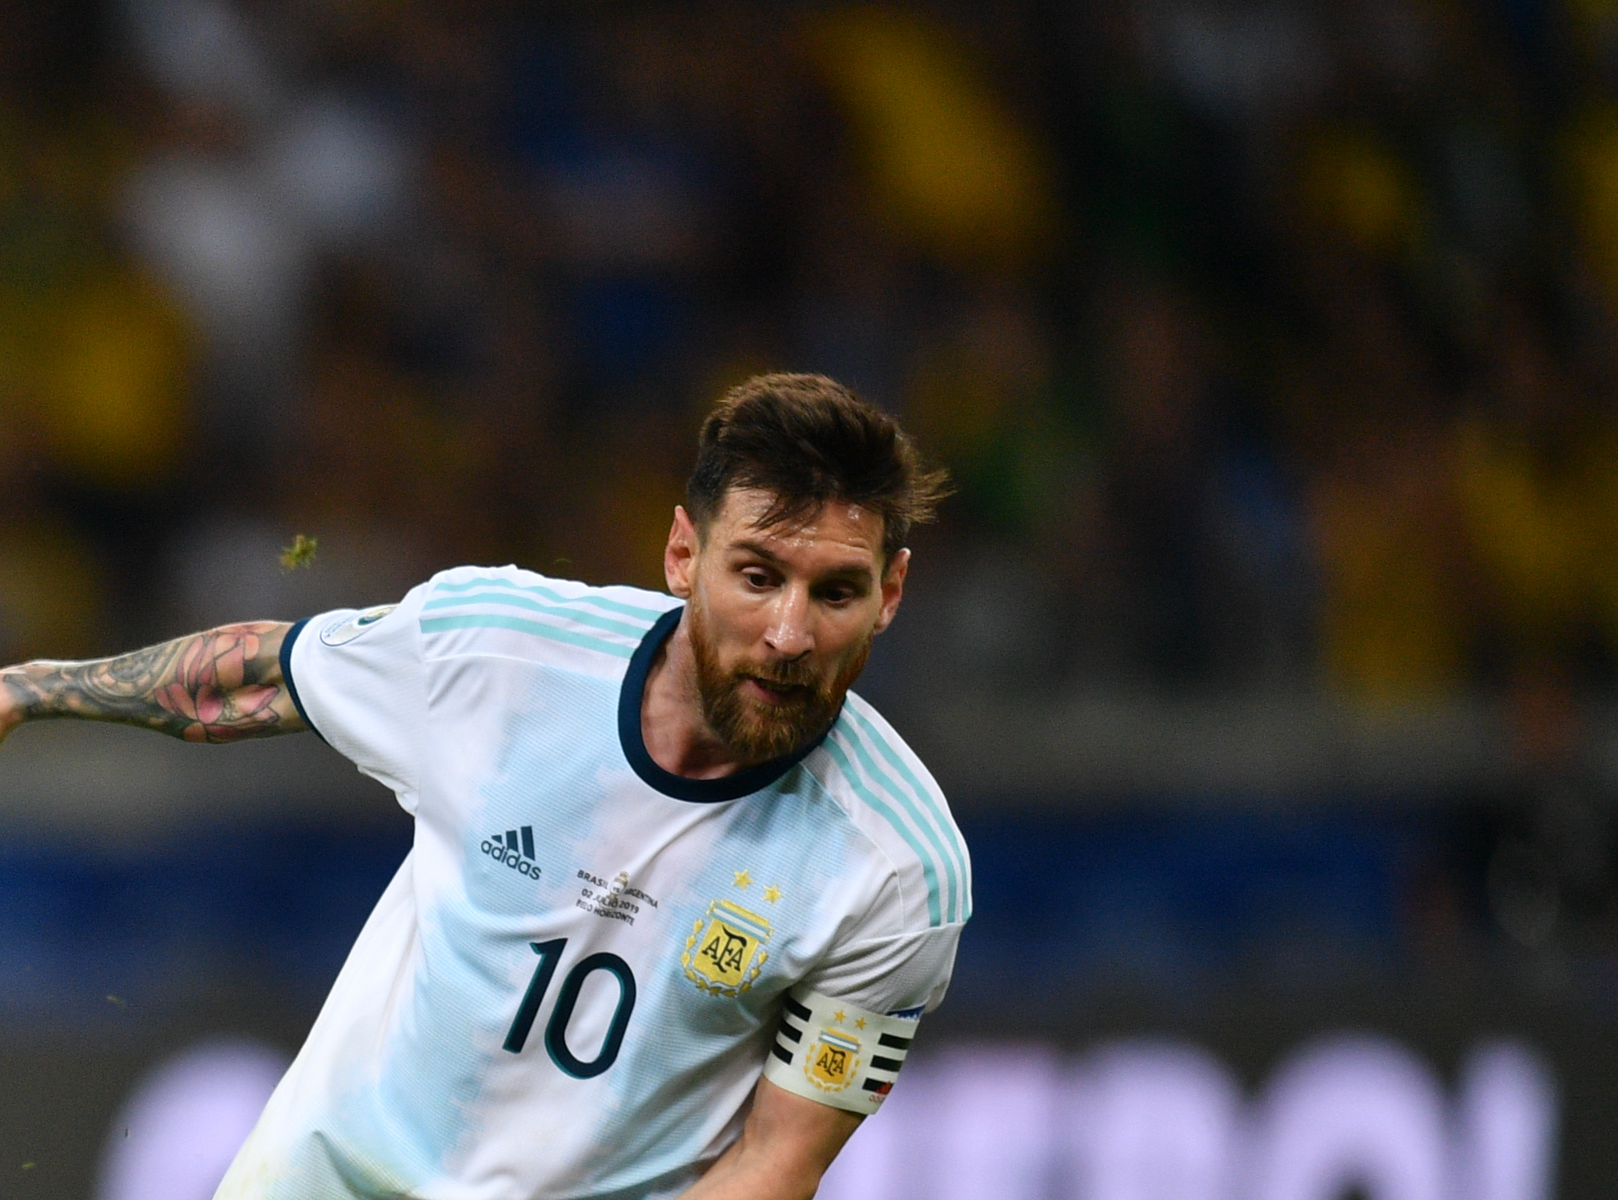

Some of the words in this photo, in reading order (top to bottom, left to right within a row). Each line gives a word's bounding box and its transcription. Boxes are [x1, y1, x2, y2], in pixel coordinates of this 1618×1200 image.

[481, 840, 542, 880] adidas
[577, 869, 608, 889] BRASIL
[624, 888, 658, 908] ARGENTINA
[581, 888, 594, 899] 02
[592, 894, 619, 908] JULIO
[619, 900, 640, 914] 2019
[593, 907, 635, 926] HORIZONTE
[701, 923, 748, 975] AFA
[502, 937, 637, 1080] 10
[816, 1045, 847, 1077] AFA
